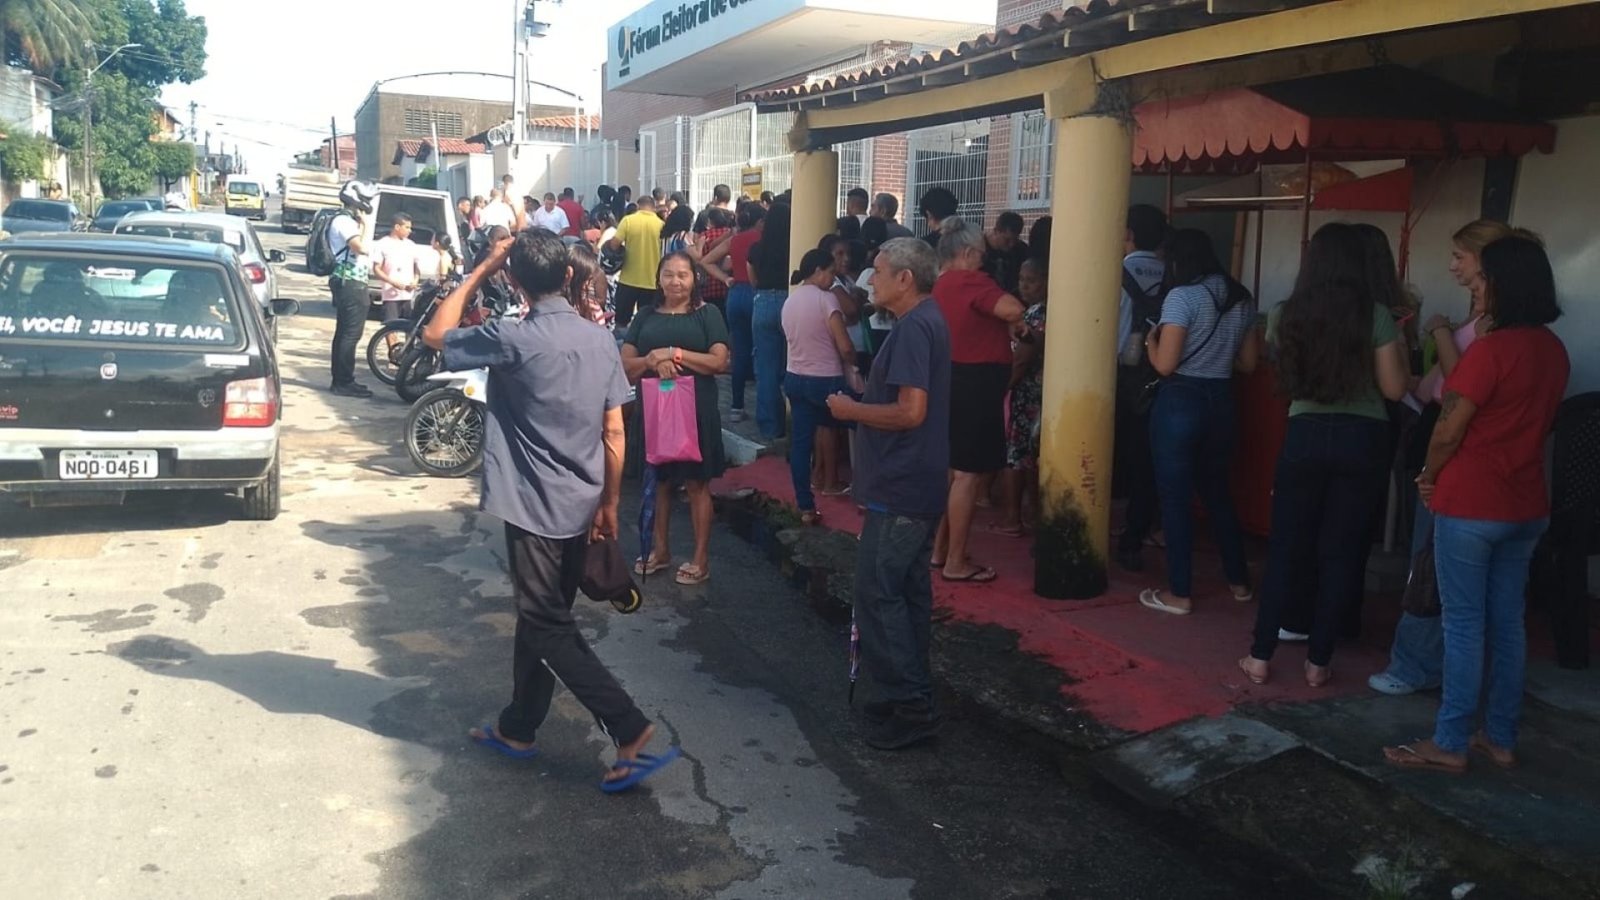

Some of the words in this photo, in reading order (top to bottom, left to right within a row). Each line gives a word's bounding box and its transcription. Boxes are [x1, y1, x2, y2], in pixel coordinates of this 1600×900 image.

[630, 25, 661, 58] Fórum
[22, 315, 82, 333] VOCÊ!
[89, 320, 150, 336] JESUS
[154, 322, 177, 338] TE
[180, 325, 224, 341] AMA
